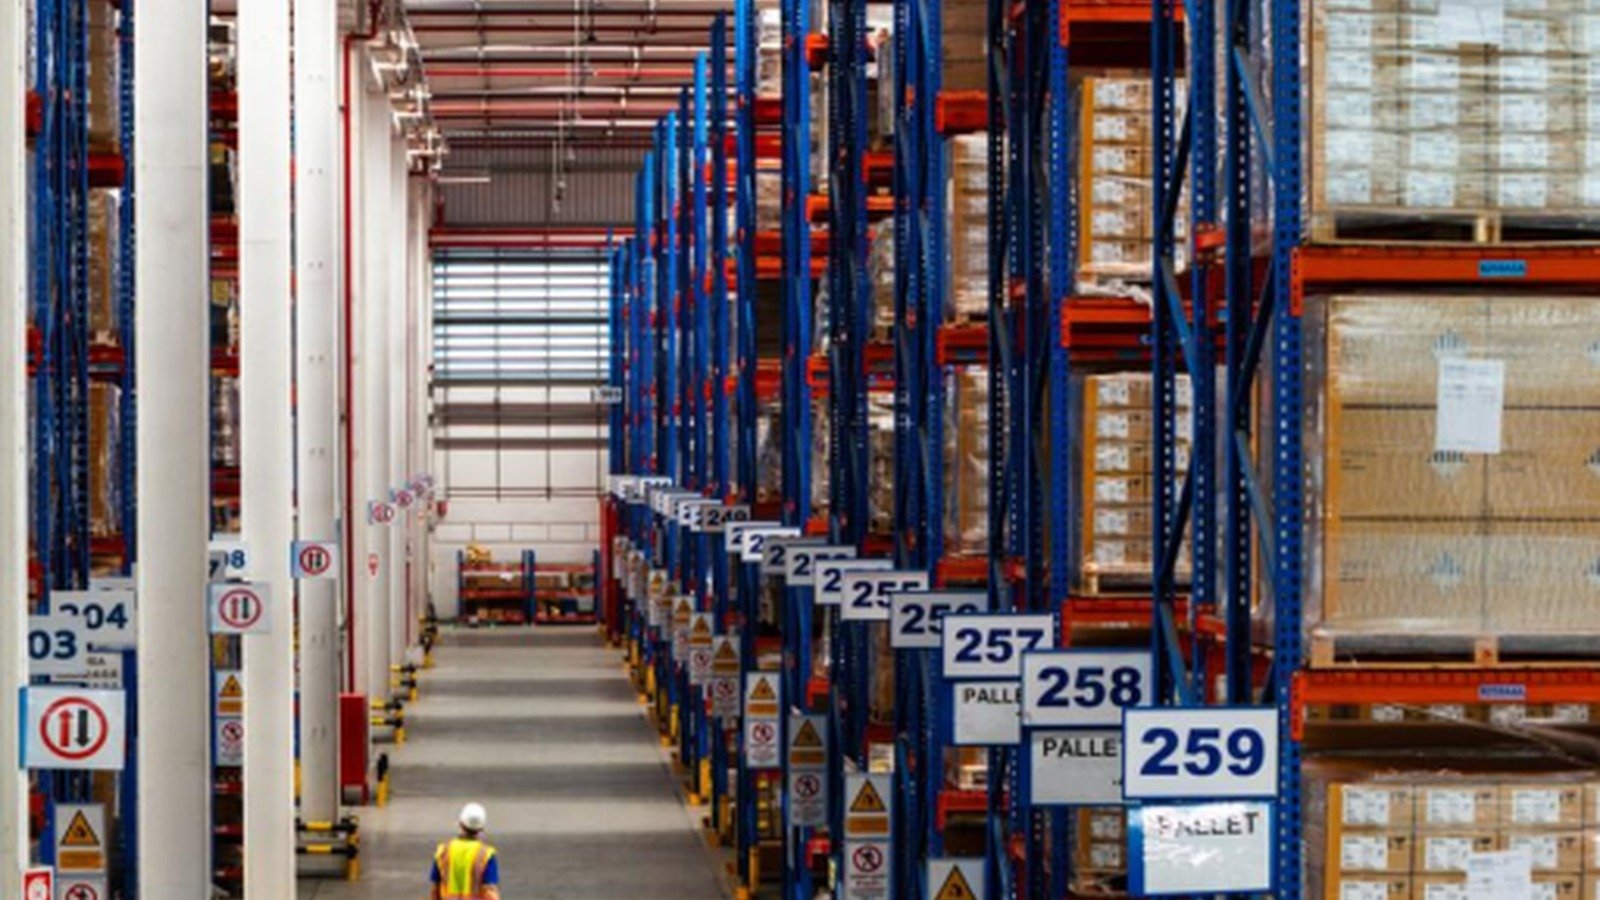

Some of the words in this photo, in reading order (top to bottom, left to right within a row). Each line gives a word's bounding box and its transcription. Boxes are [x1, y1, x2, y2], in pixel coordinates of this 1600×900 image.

[954, 628, 1045, 663] 257
[1036, 666, 1142, 708] 258
[1140, 727, 1264, 777] 259
